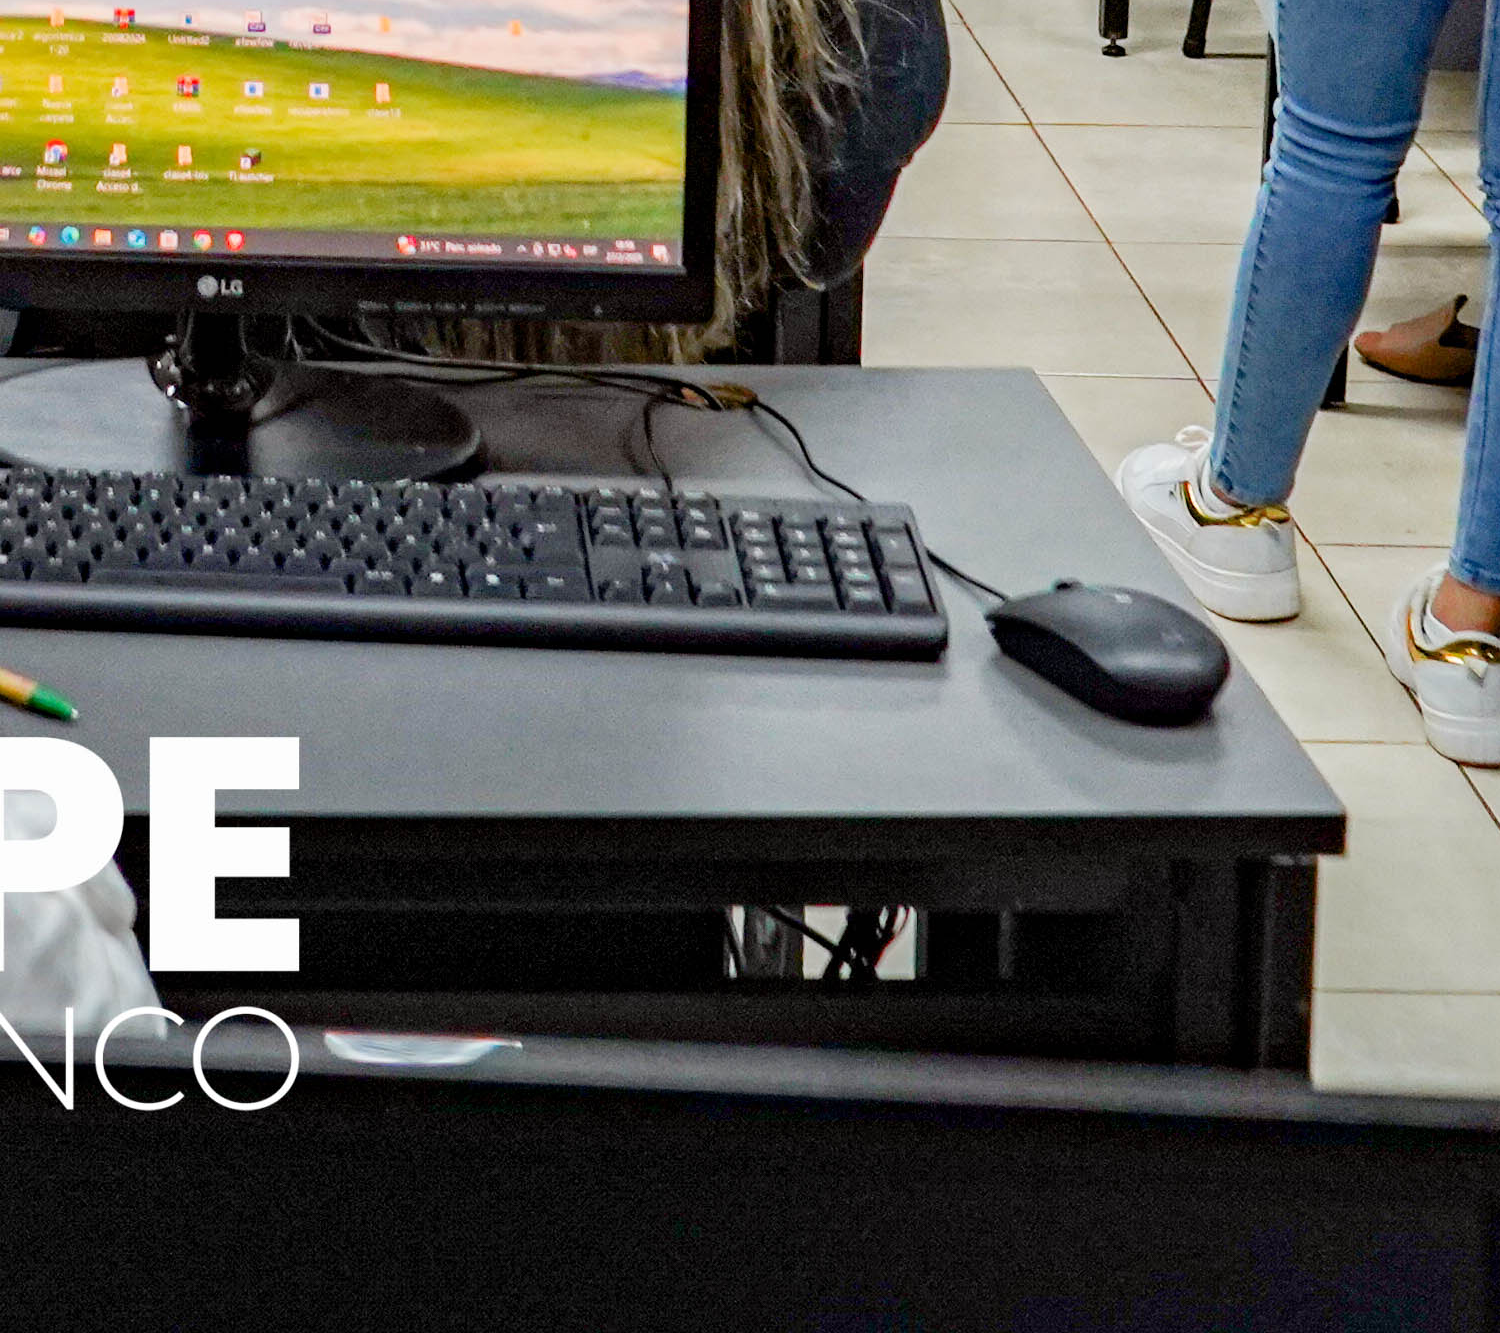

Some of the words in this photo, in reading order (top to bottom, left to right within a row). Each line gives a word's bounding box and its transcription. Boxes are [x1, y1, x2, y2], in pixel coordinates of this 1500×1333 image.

[3, 164, 21, 175] arce
[37, 180, 72, 190] Chrome
[220, 279, 244, 295] LG
